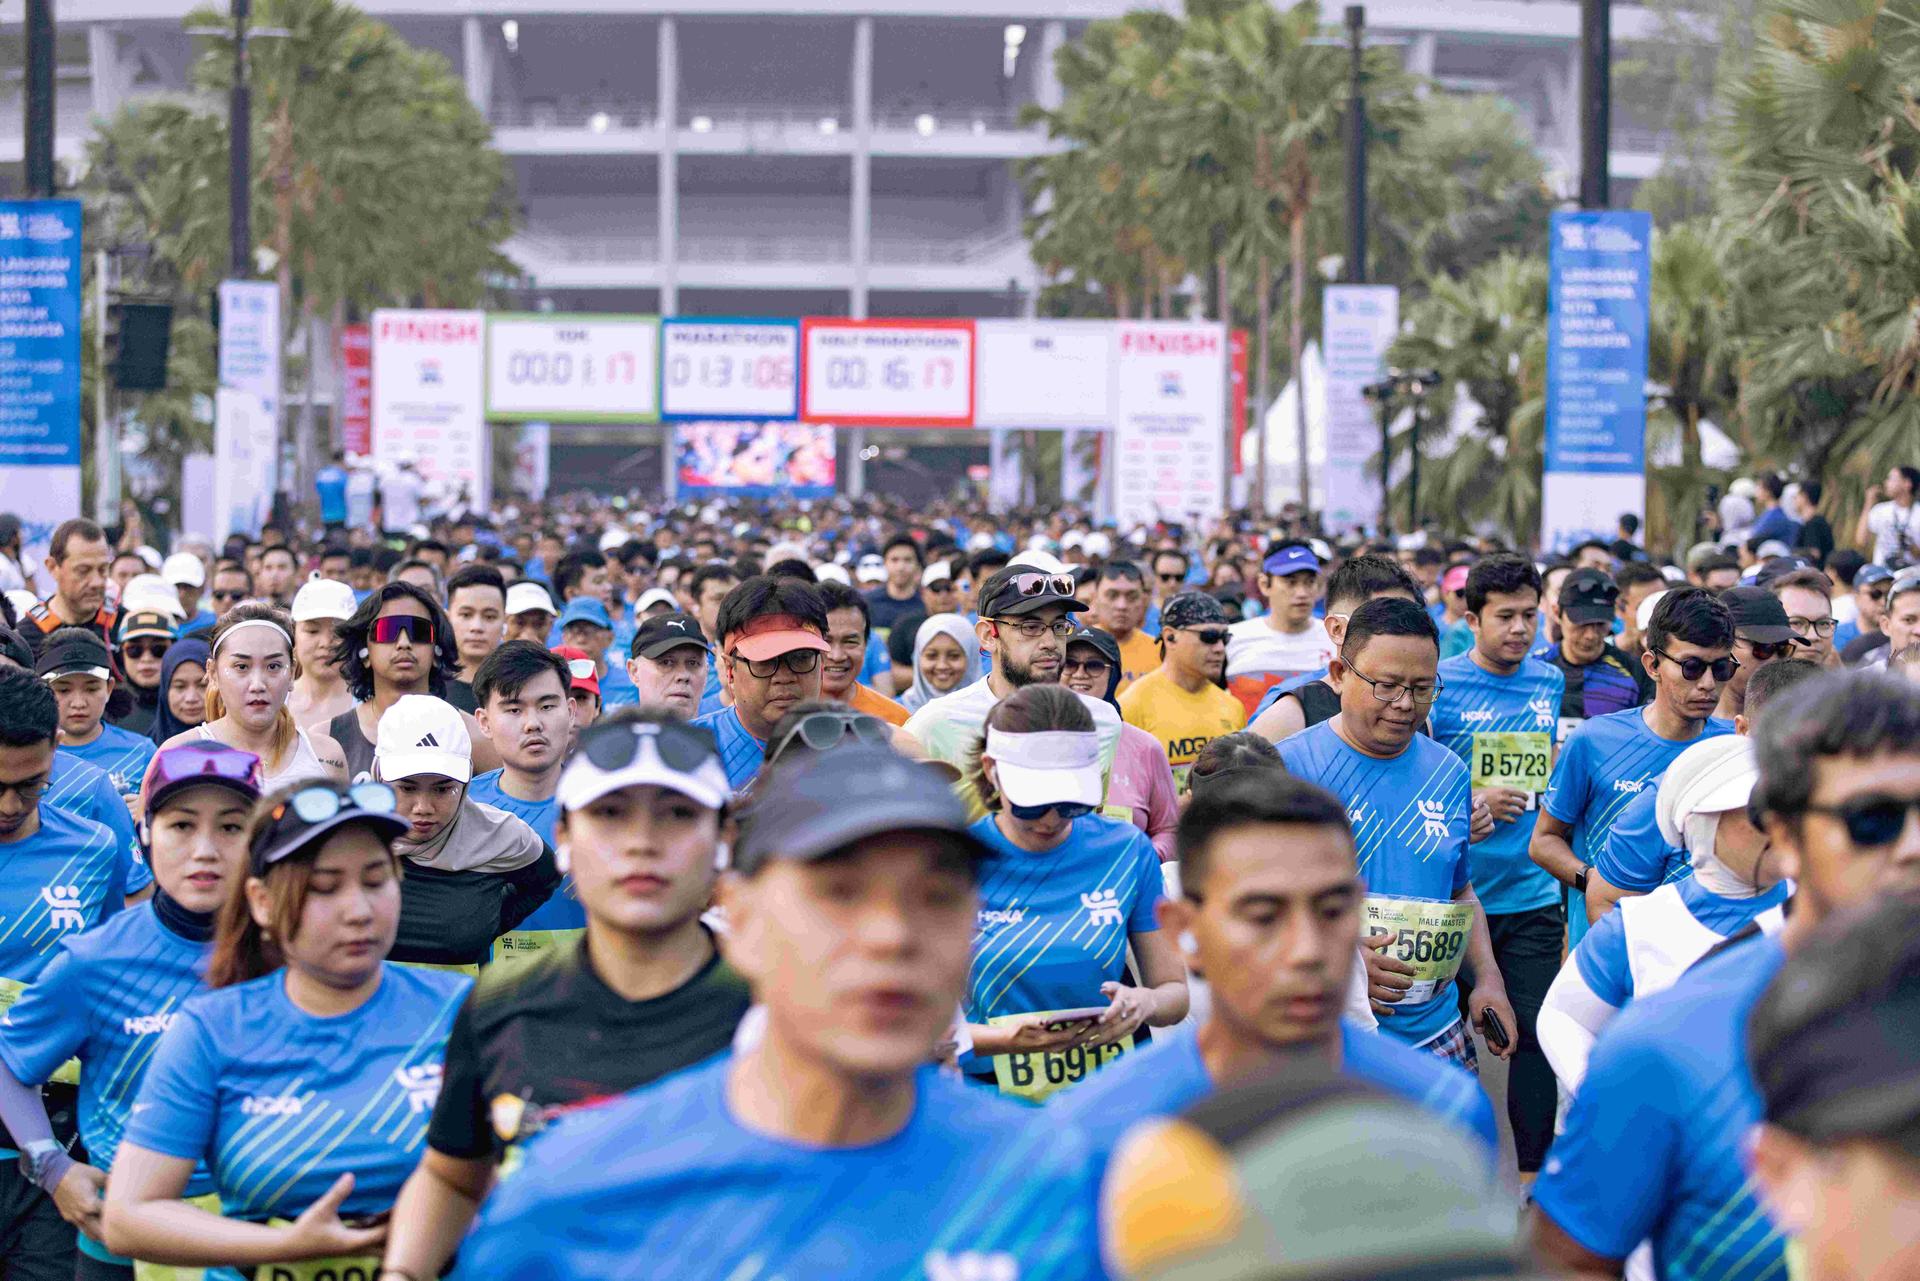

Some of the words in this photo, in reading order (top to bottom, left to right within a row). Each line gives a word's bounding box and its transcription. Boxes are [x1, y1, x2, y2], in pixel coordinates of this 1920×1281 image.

[380, 319, 480, 344] FINISH
[673, 331, 788, 344] MARATHON
[864, 337, 960, 349] MARATHON
[1120, 332, 1218, 355] FINISH
[1461, 711, 1493, 722] HOKA
[1168, 737, 1212, 758] MDG
[1480, 753, 1495, 777] B
[1500, 753, 1547, 777] 5723
[1613, 779, 1645, 793] HOK
[977, 910, 1023, 924] HOKA
[1419, 917, 1440, 927] MALE
[1441, 918, 1466, 927] MASTER
[1397, 929, 1464, 963] 5689
[124, 1013, 176, 1034] HOK
[1009, 1051, 1035, 1087] B
[240, 1095, 302, 1115] HOKA
